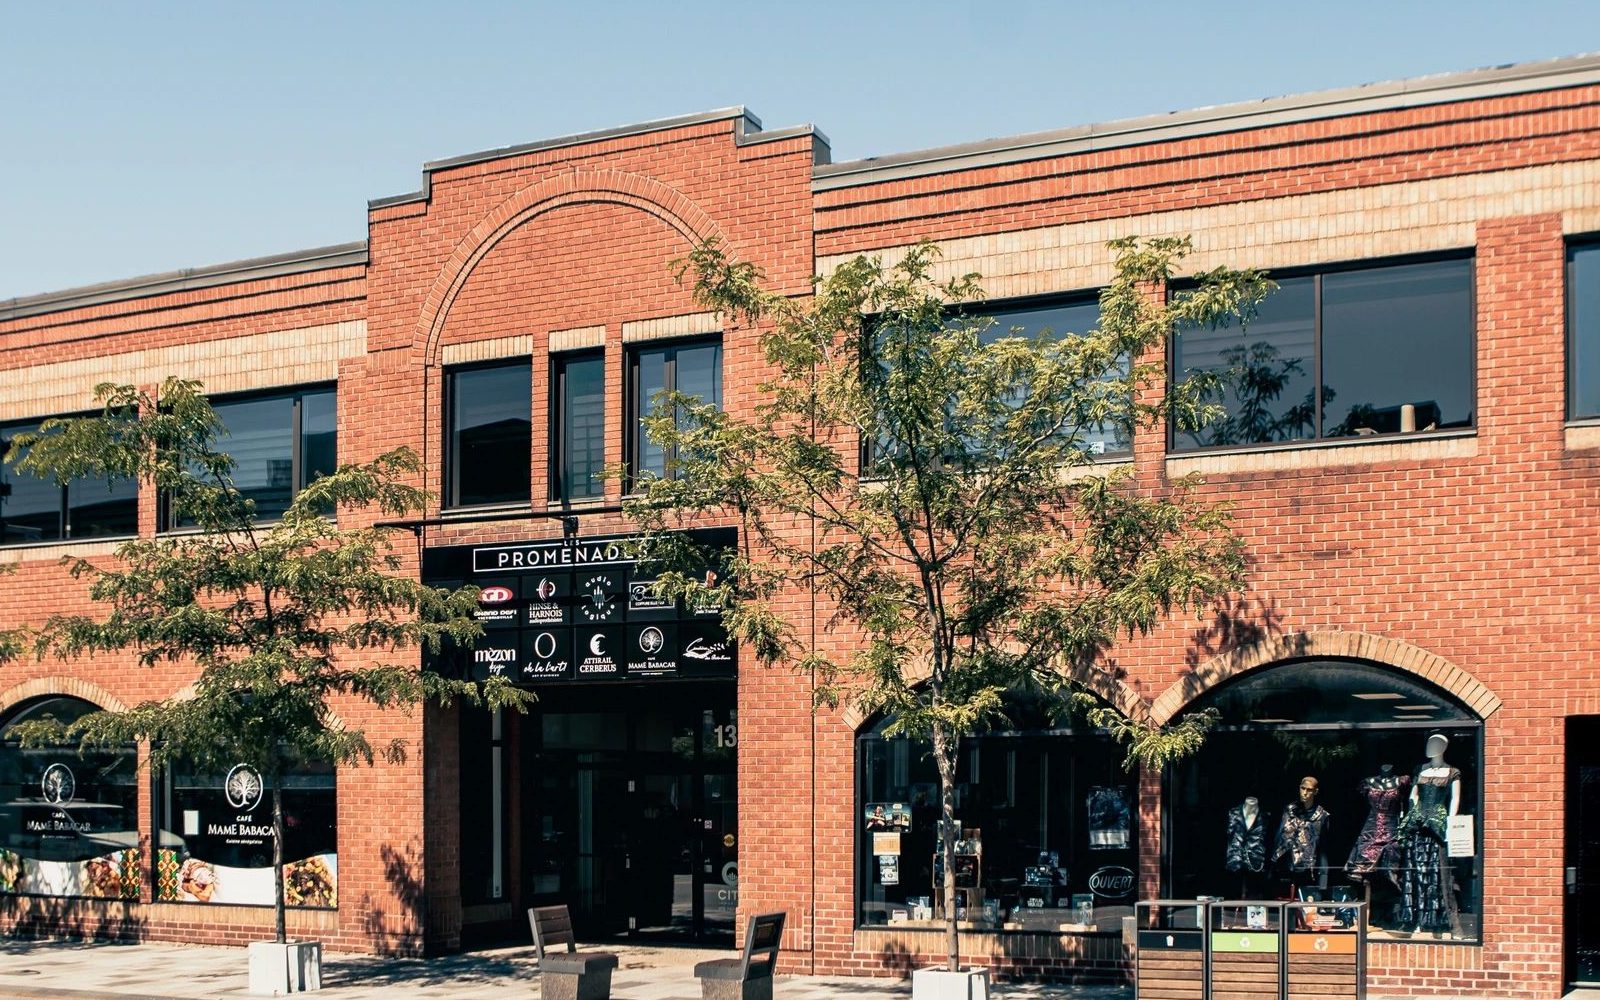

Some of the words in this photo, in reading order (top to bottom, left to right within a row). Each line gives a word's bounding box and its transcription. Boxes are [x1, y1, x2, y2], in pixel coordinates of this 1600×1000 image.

[498, 546, 648, 567] PROMENAD
[585, 576, 612, 588] audio
[529, 609, 562, 618] HARNOIS
[581, 604, 616, 620] logique
[475, 647, 516, 662] mèzon
[580, 664, 617, 672] CERBERUS
[648, 661, 676, 669] BABACAR
[236, 814, 252, 822] CAFÉ
[26, 820, 52, 830] MAME
[54, 820, 91, 831] BABACAR
[207, 823, 238, 835] MAME
[239, 823, 275, 836] BABACA
[1091, 875, 1135, 889] OUVERT
